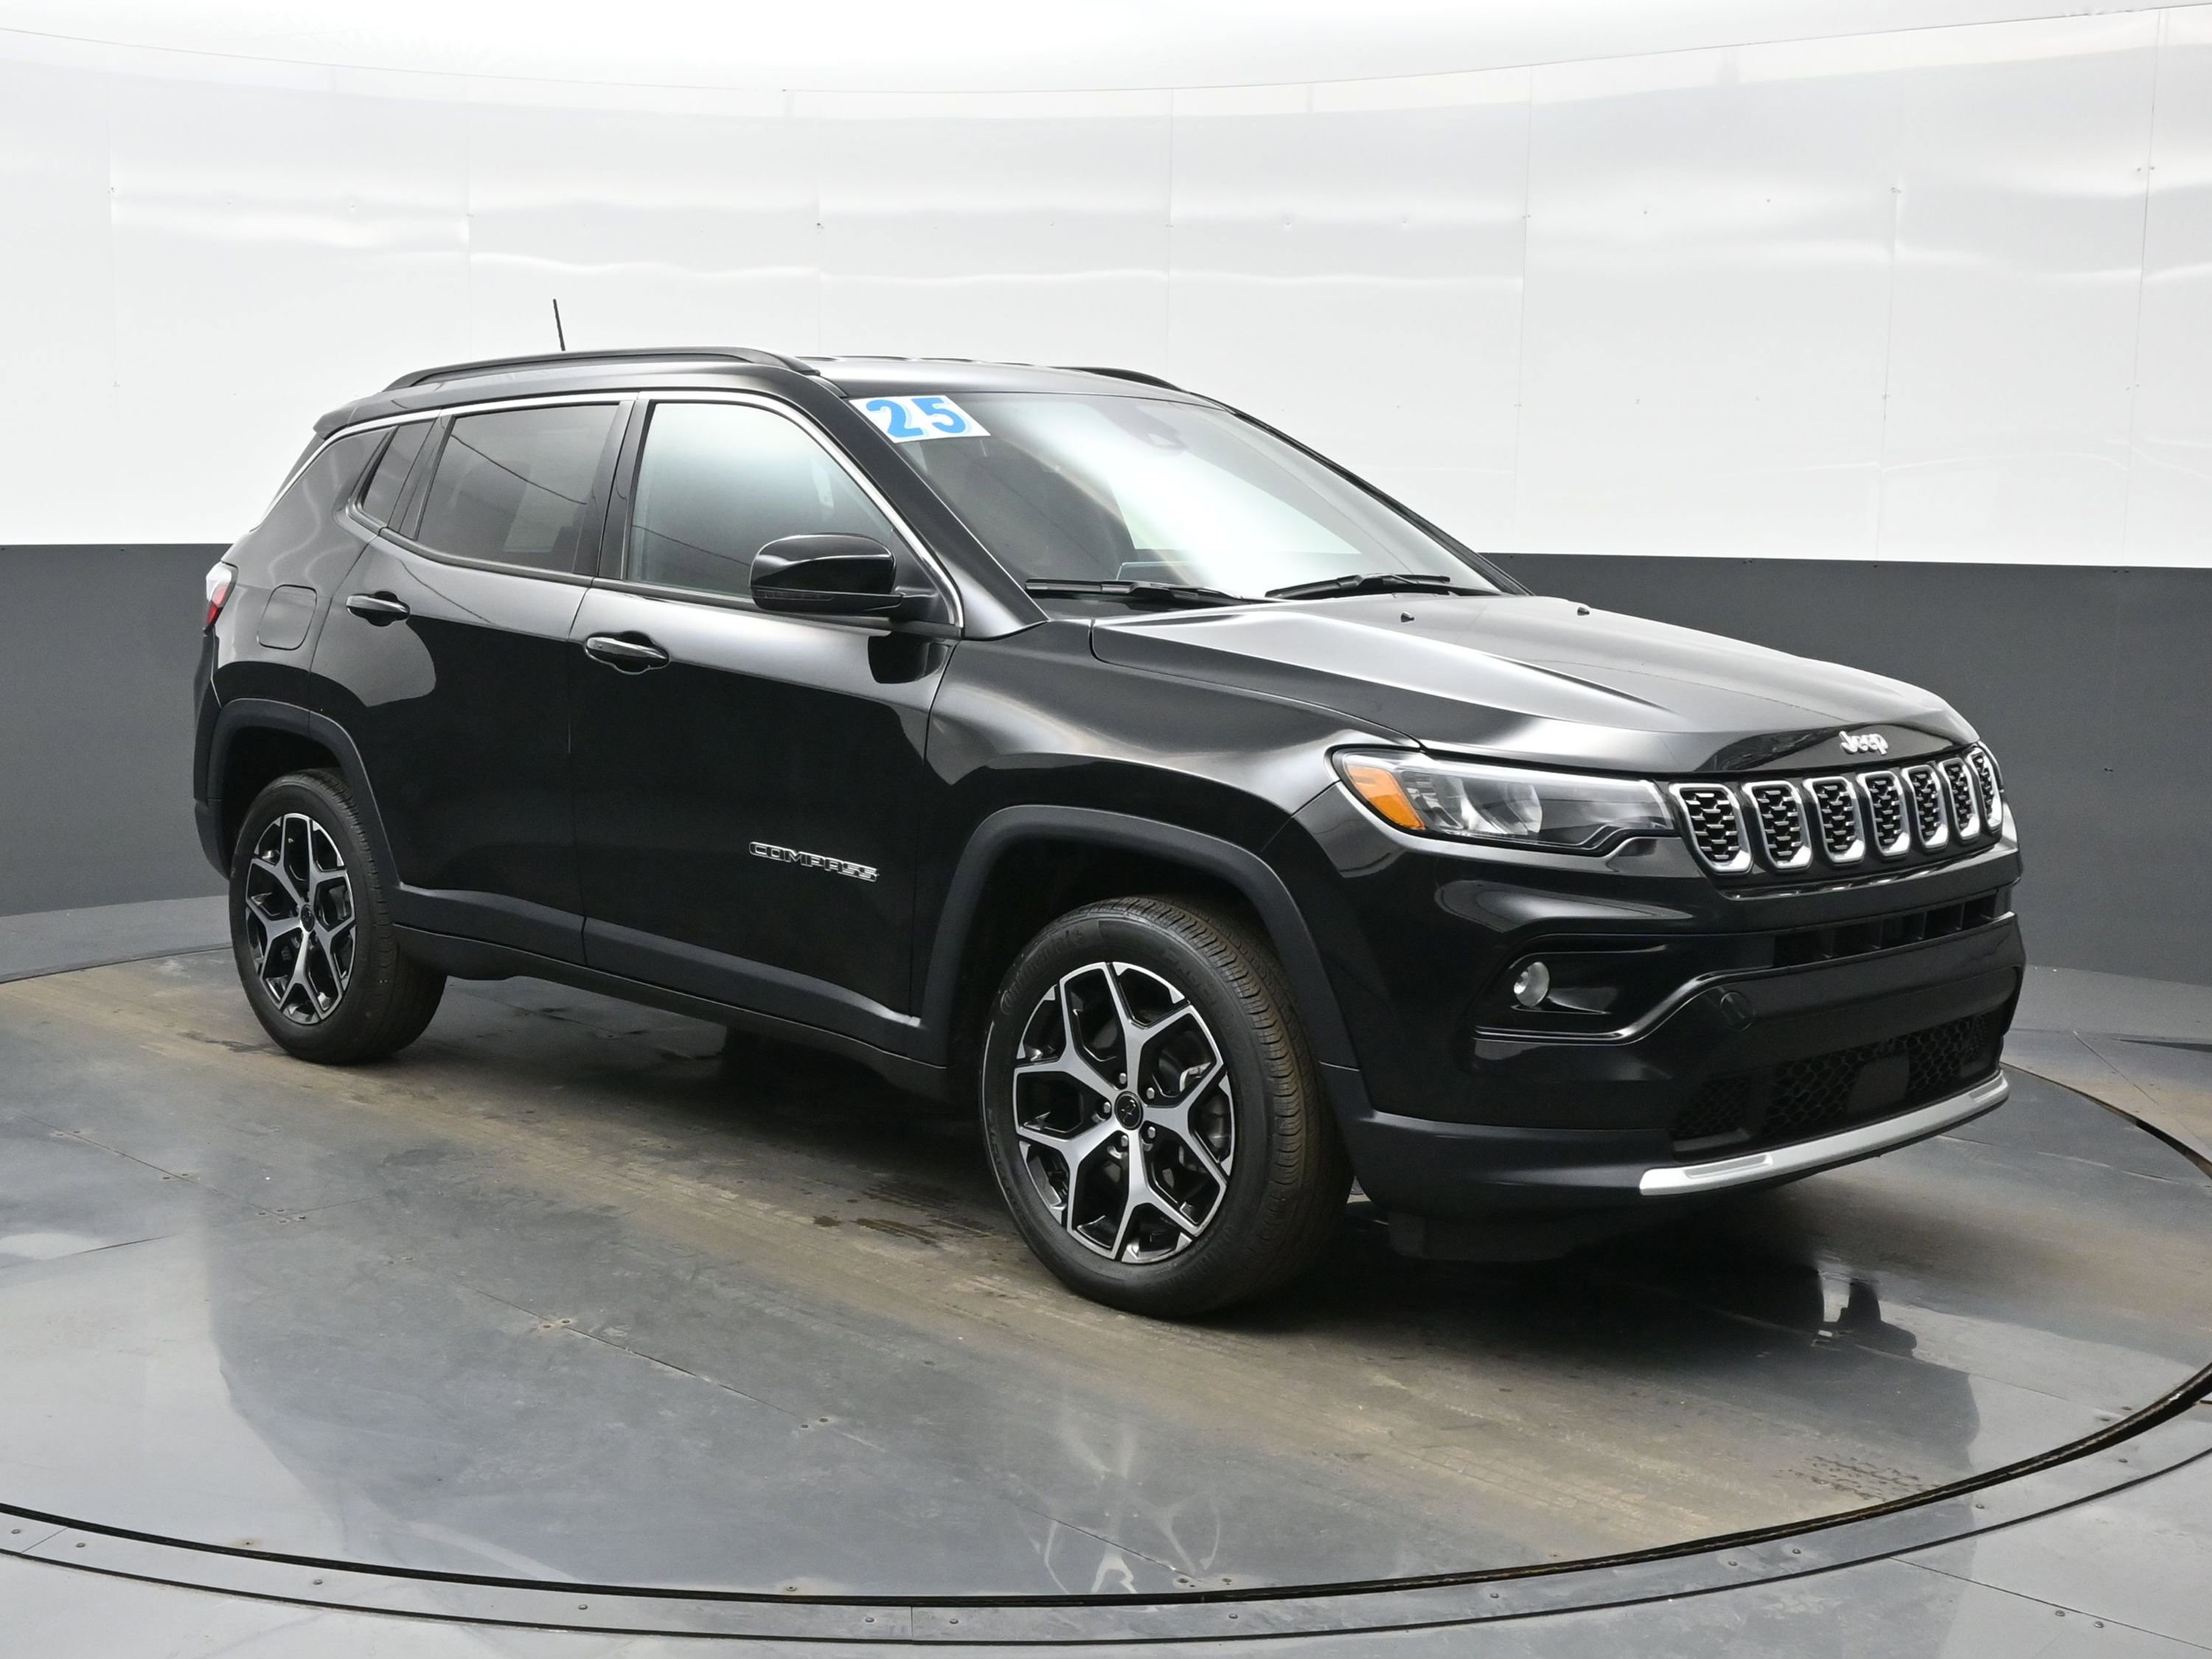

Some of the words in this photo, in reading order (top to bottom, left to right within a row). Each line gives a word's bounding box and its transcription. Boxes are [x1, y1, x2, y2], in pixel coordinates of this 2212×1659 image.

[866, 397, 967, 438] 25
[1839, 731, 1888, 755] Jeep
[748, 841, 880, 883] COMPASS
